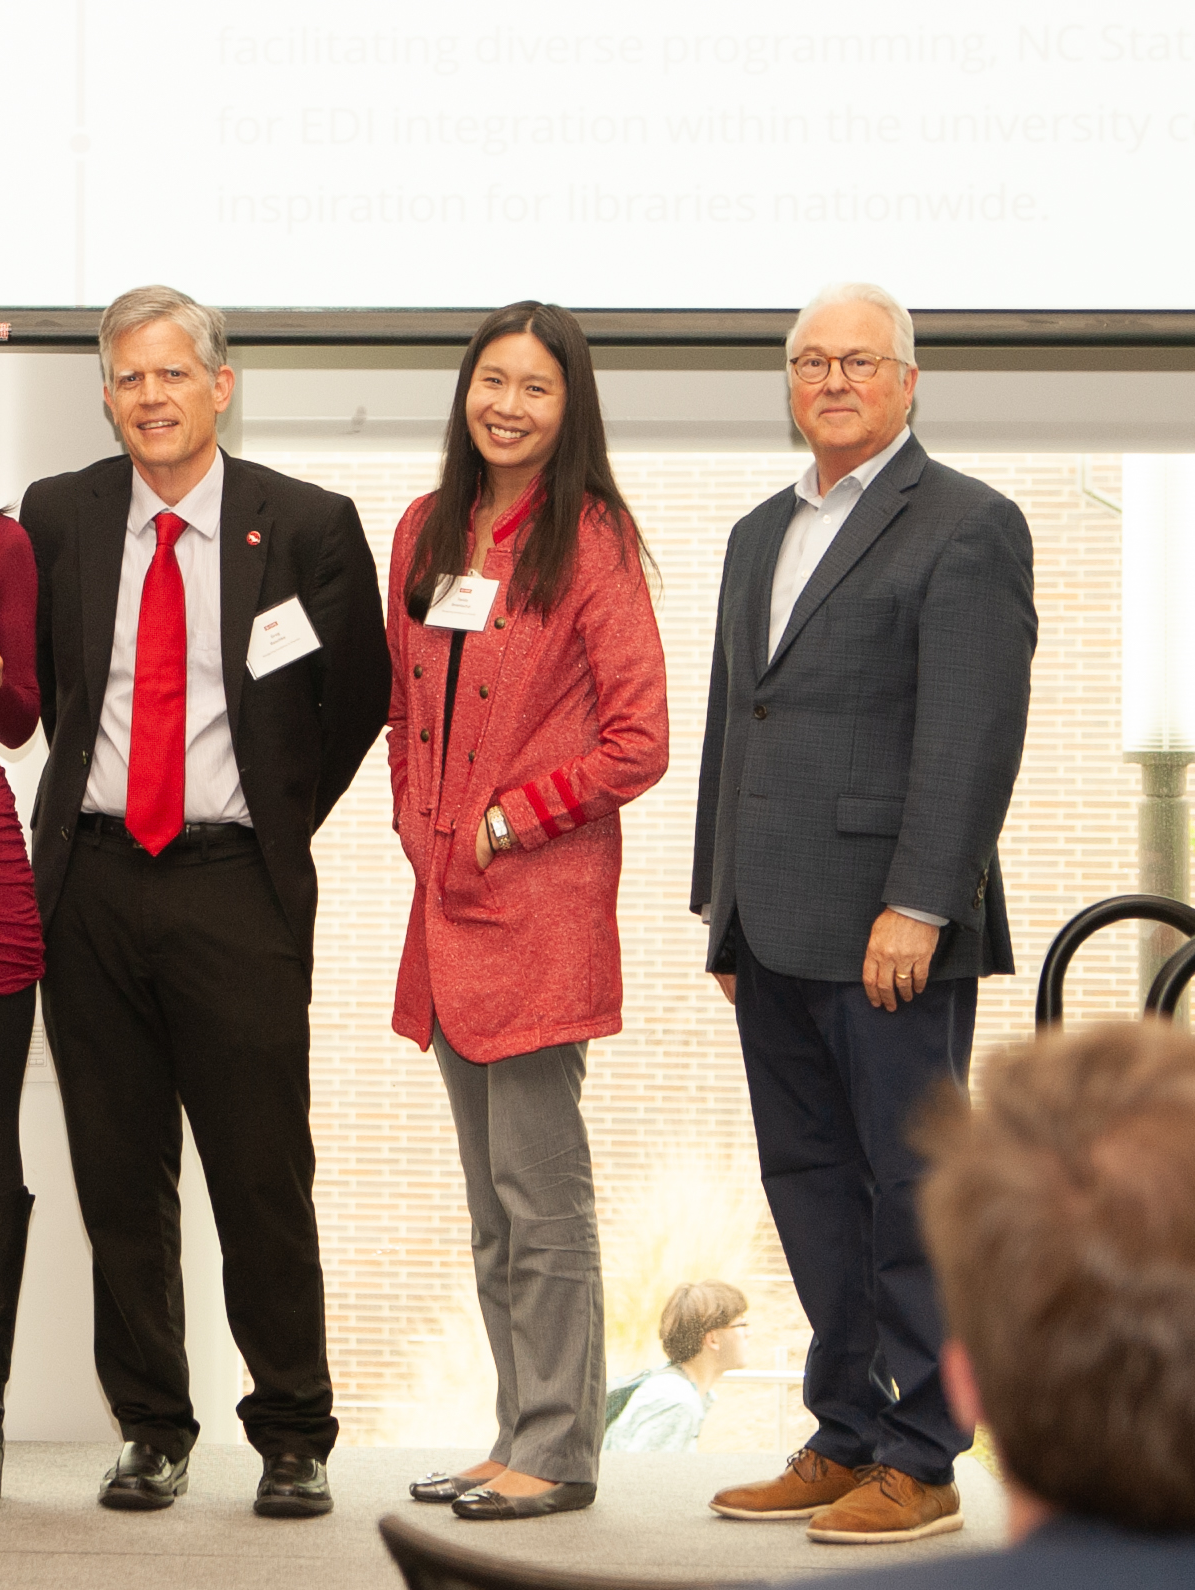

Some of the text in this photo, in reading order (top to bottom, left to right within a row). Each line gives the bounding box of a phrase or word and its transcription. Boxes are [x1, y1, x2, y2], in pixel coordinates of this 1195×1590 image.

[216, 22, 1195, 77] facilitating diverse programming, NC Stat
[215, 104, 283, 146] for
[300, 106, 375, 146] EDI
[392, 106, 649, 157] integration
[664, 104, 810, 146] within
[824, 104, 903, 146] the
[919, 103, 1153, 156] university
[216, 181, 1051, 236] inspiration for libraries nationwide.
